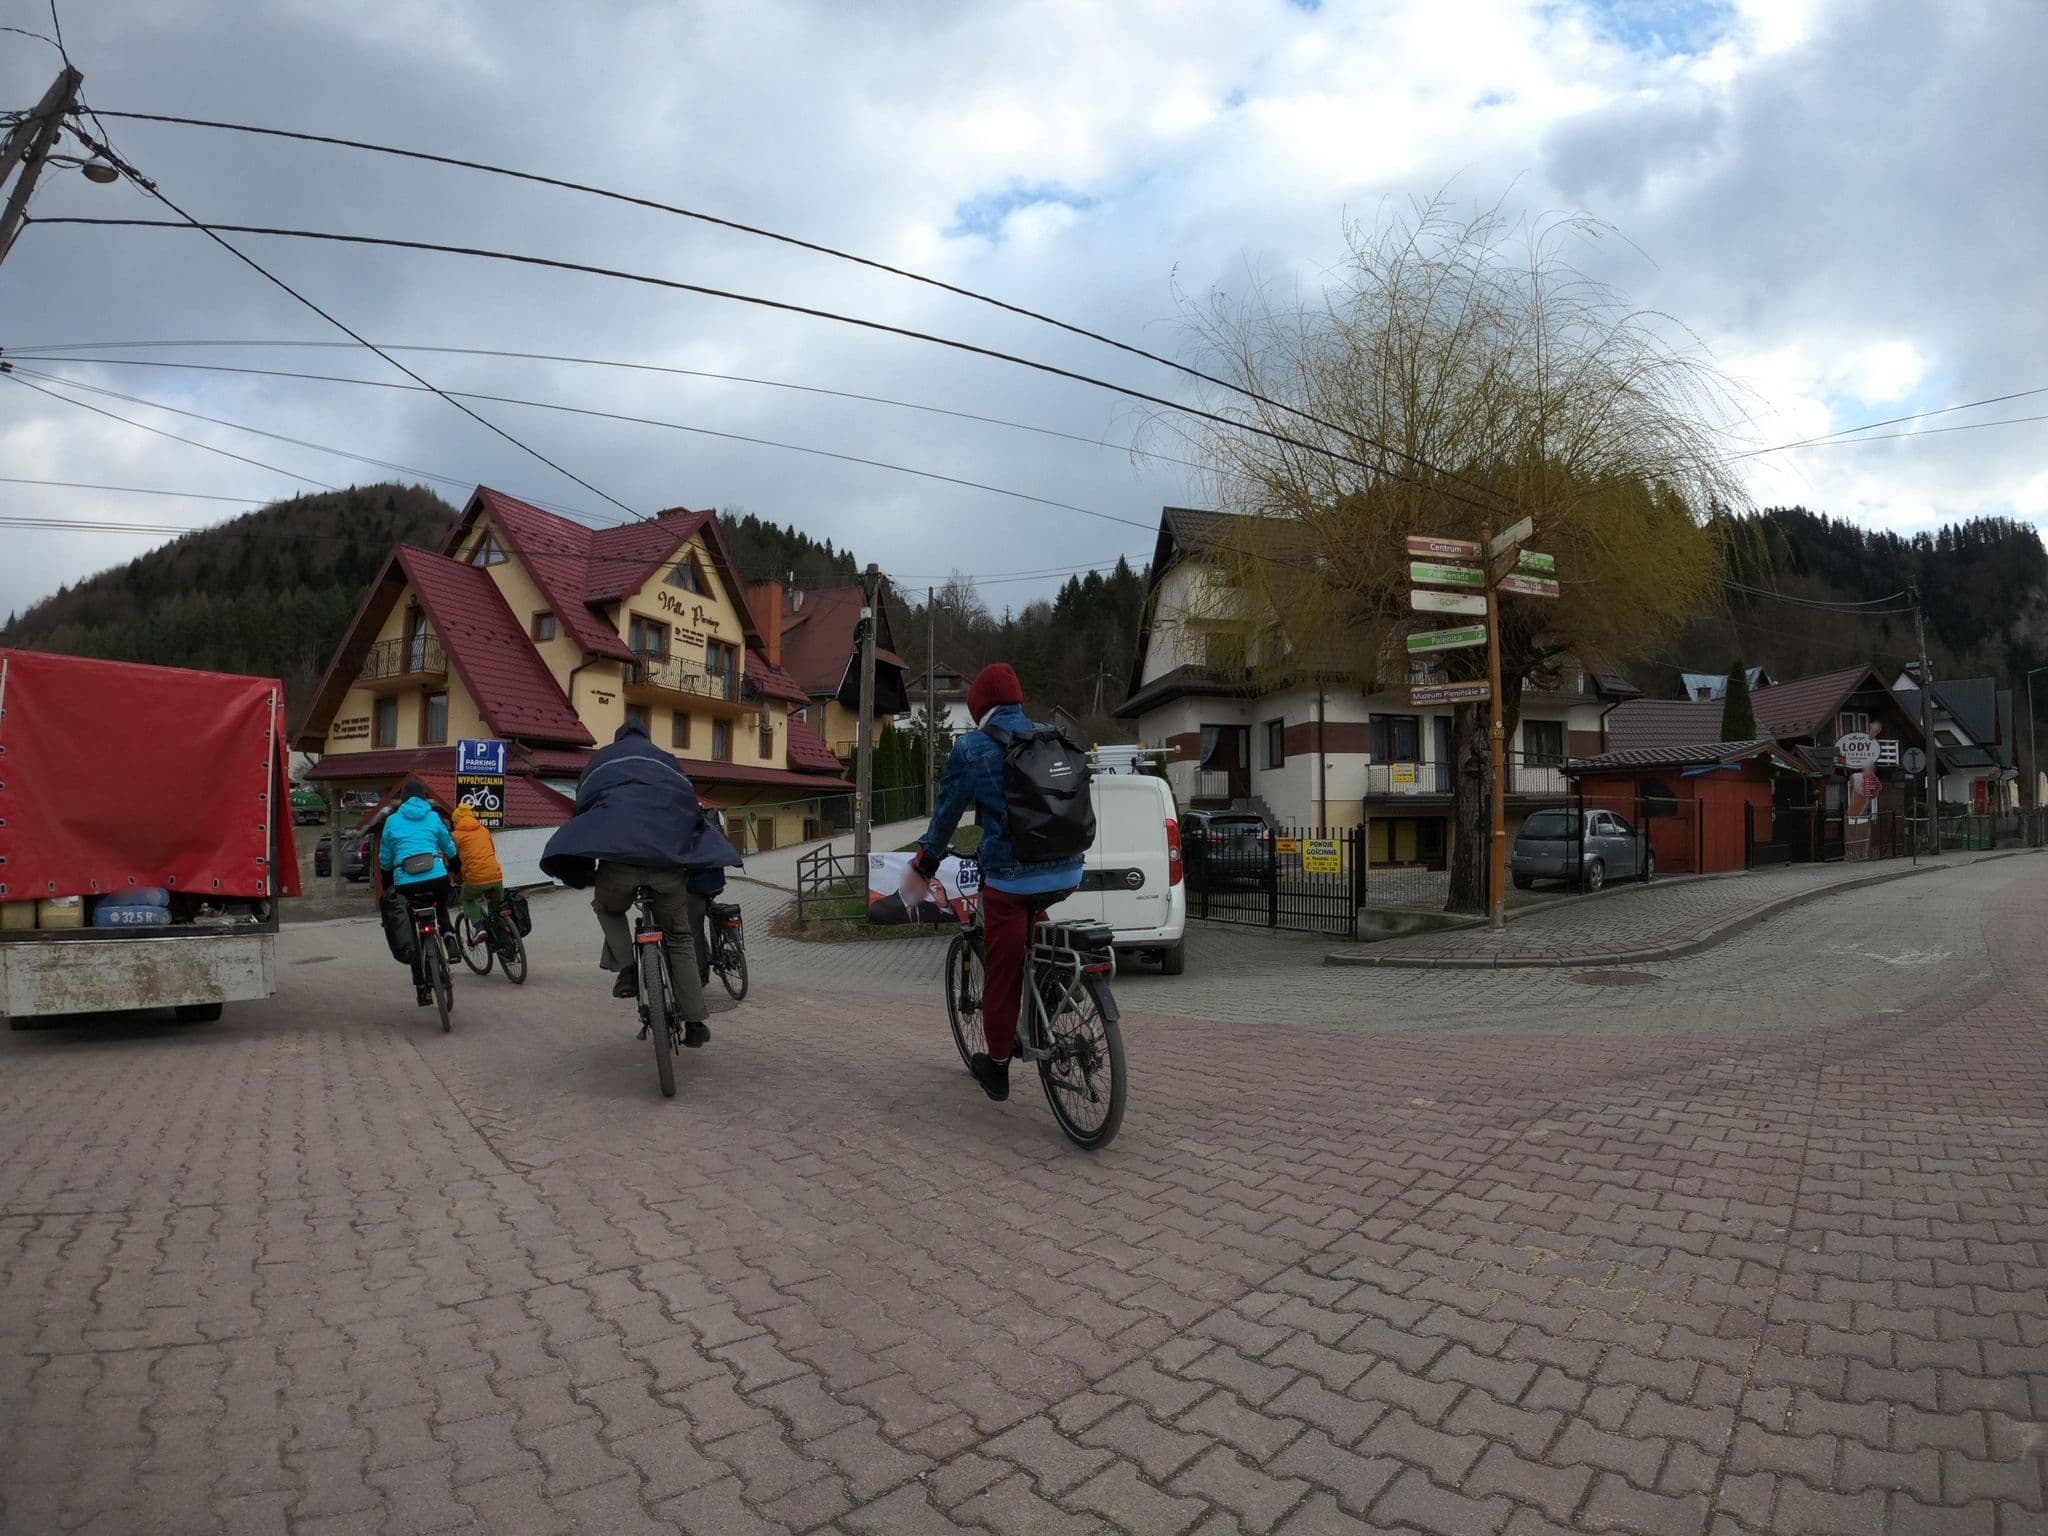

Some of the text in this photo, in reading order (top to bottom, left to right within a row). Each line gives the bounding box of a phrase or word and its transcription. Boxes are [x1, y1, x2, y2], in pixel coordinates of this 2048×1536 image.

[1430, 543, 1462, 553] Centrum
[1428, 570, 1469, 581] Promenada
[1431, 634, 1463, 644] Palenica
[1413, 688, 1479, 700] Muzeum Pienińskie
[476, 743, 487, 757] P
[1842, 742, 1872, 752] LODY
[122, 911, 143, 924] 32,5
